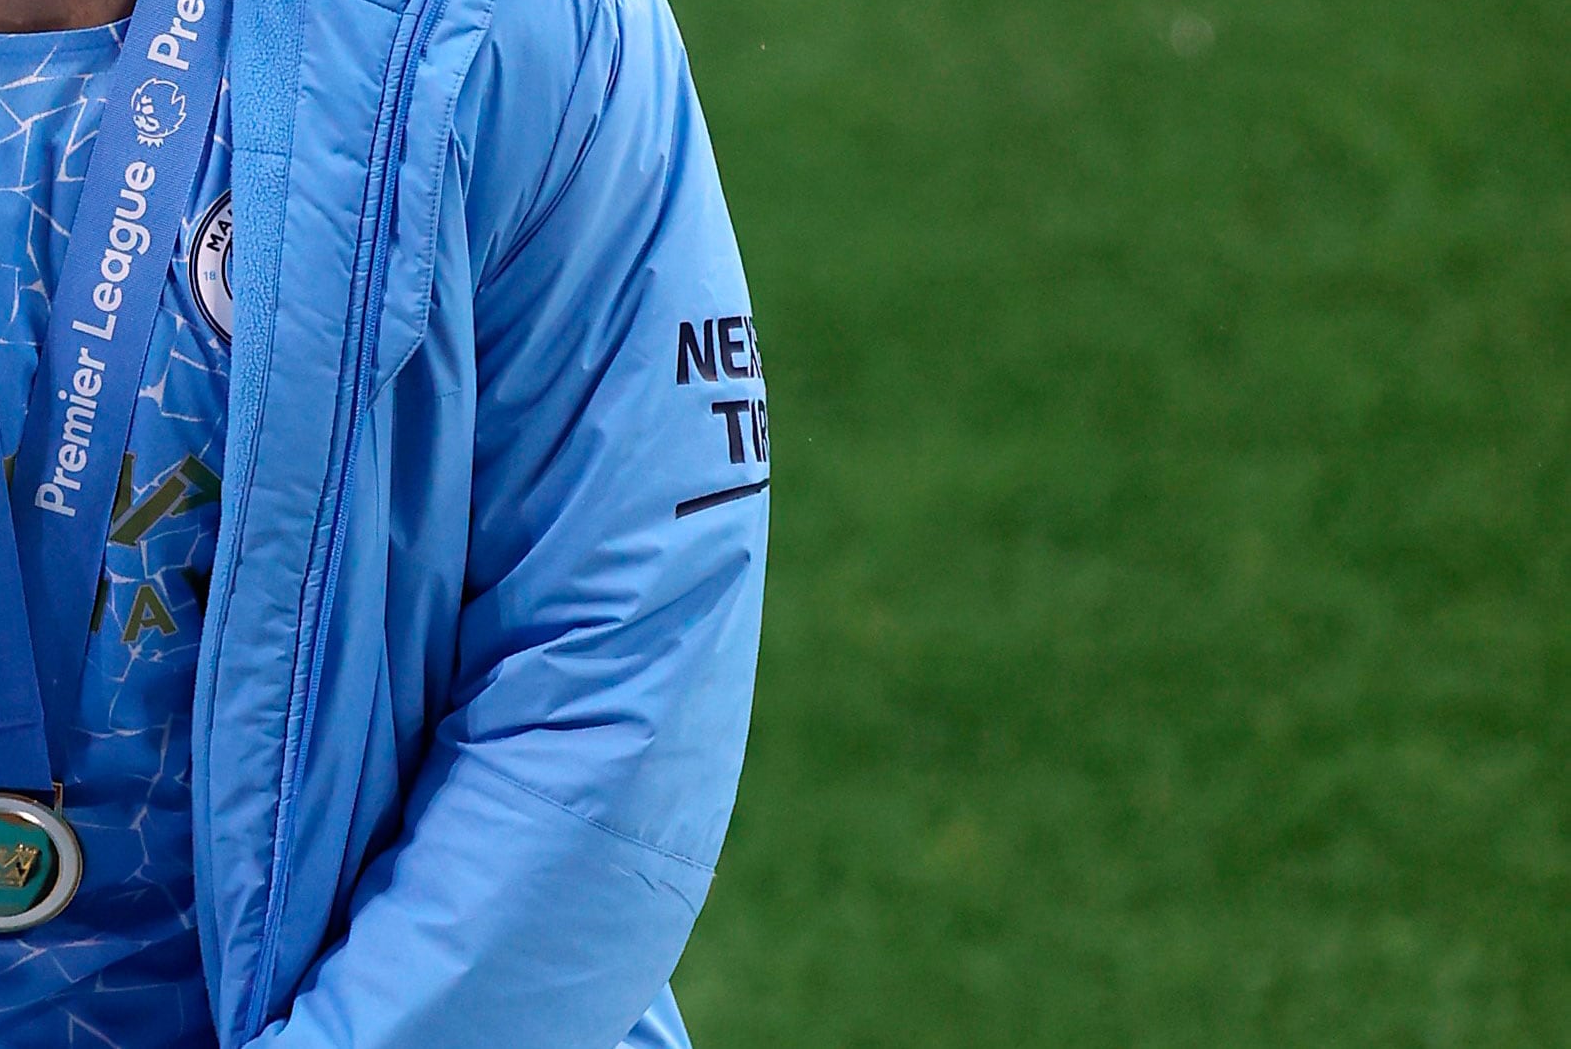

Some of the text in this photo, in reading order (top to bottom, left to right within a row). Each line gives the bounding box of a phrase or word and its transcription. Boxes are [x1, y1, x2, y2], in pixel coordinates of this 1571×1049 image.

[206, 208, 232, 252] MA
[34, 160, 156, 517] Premier League
